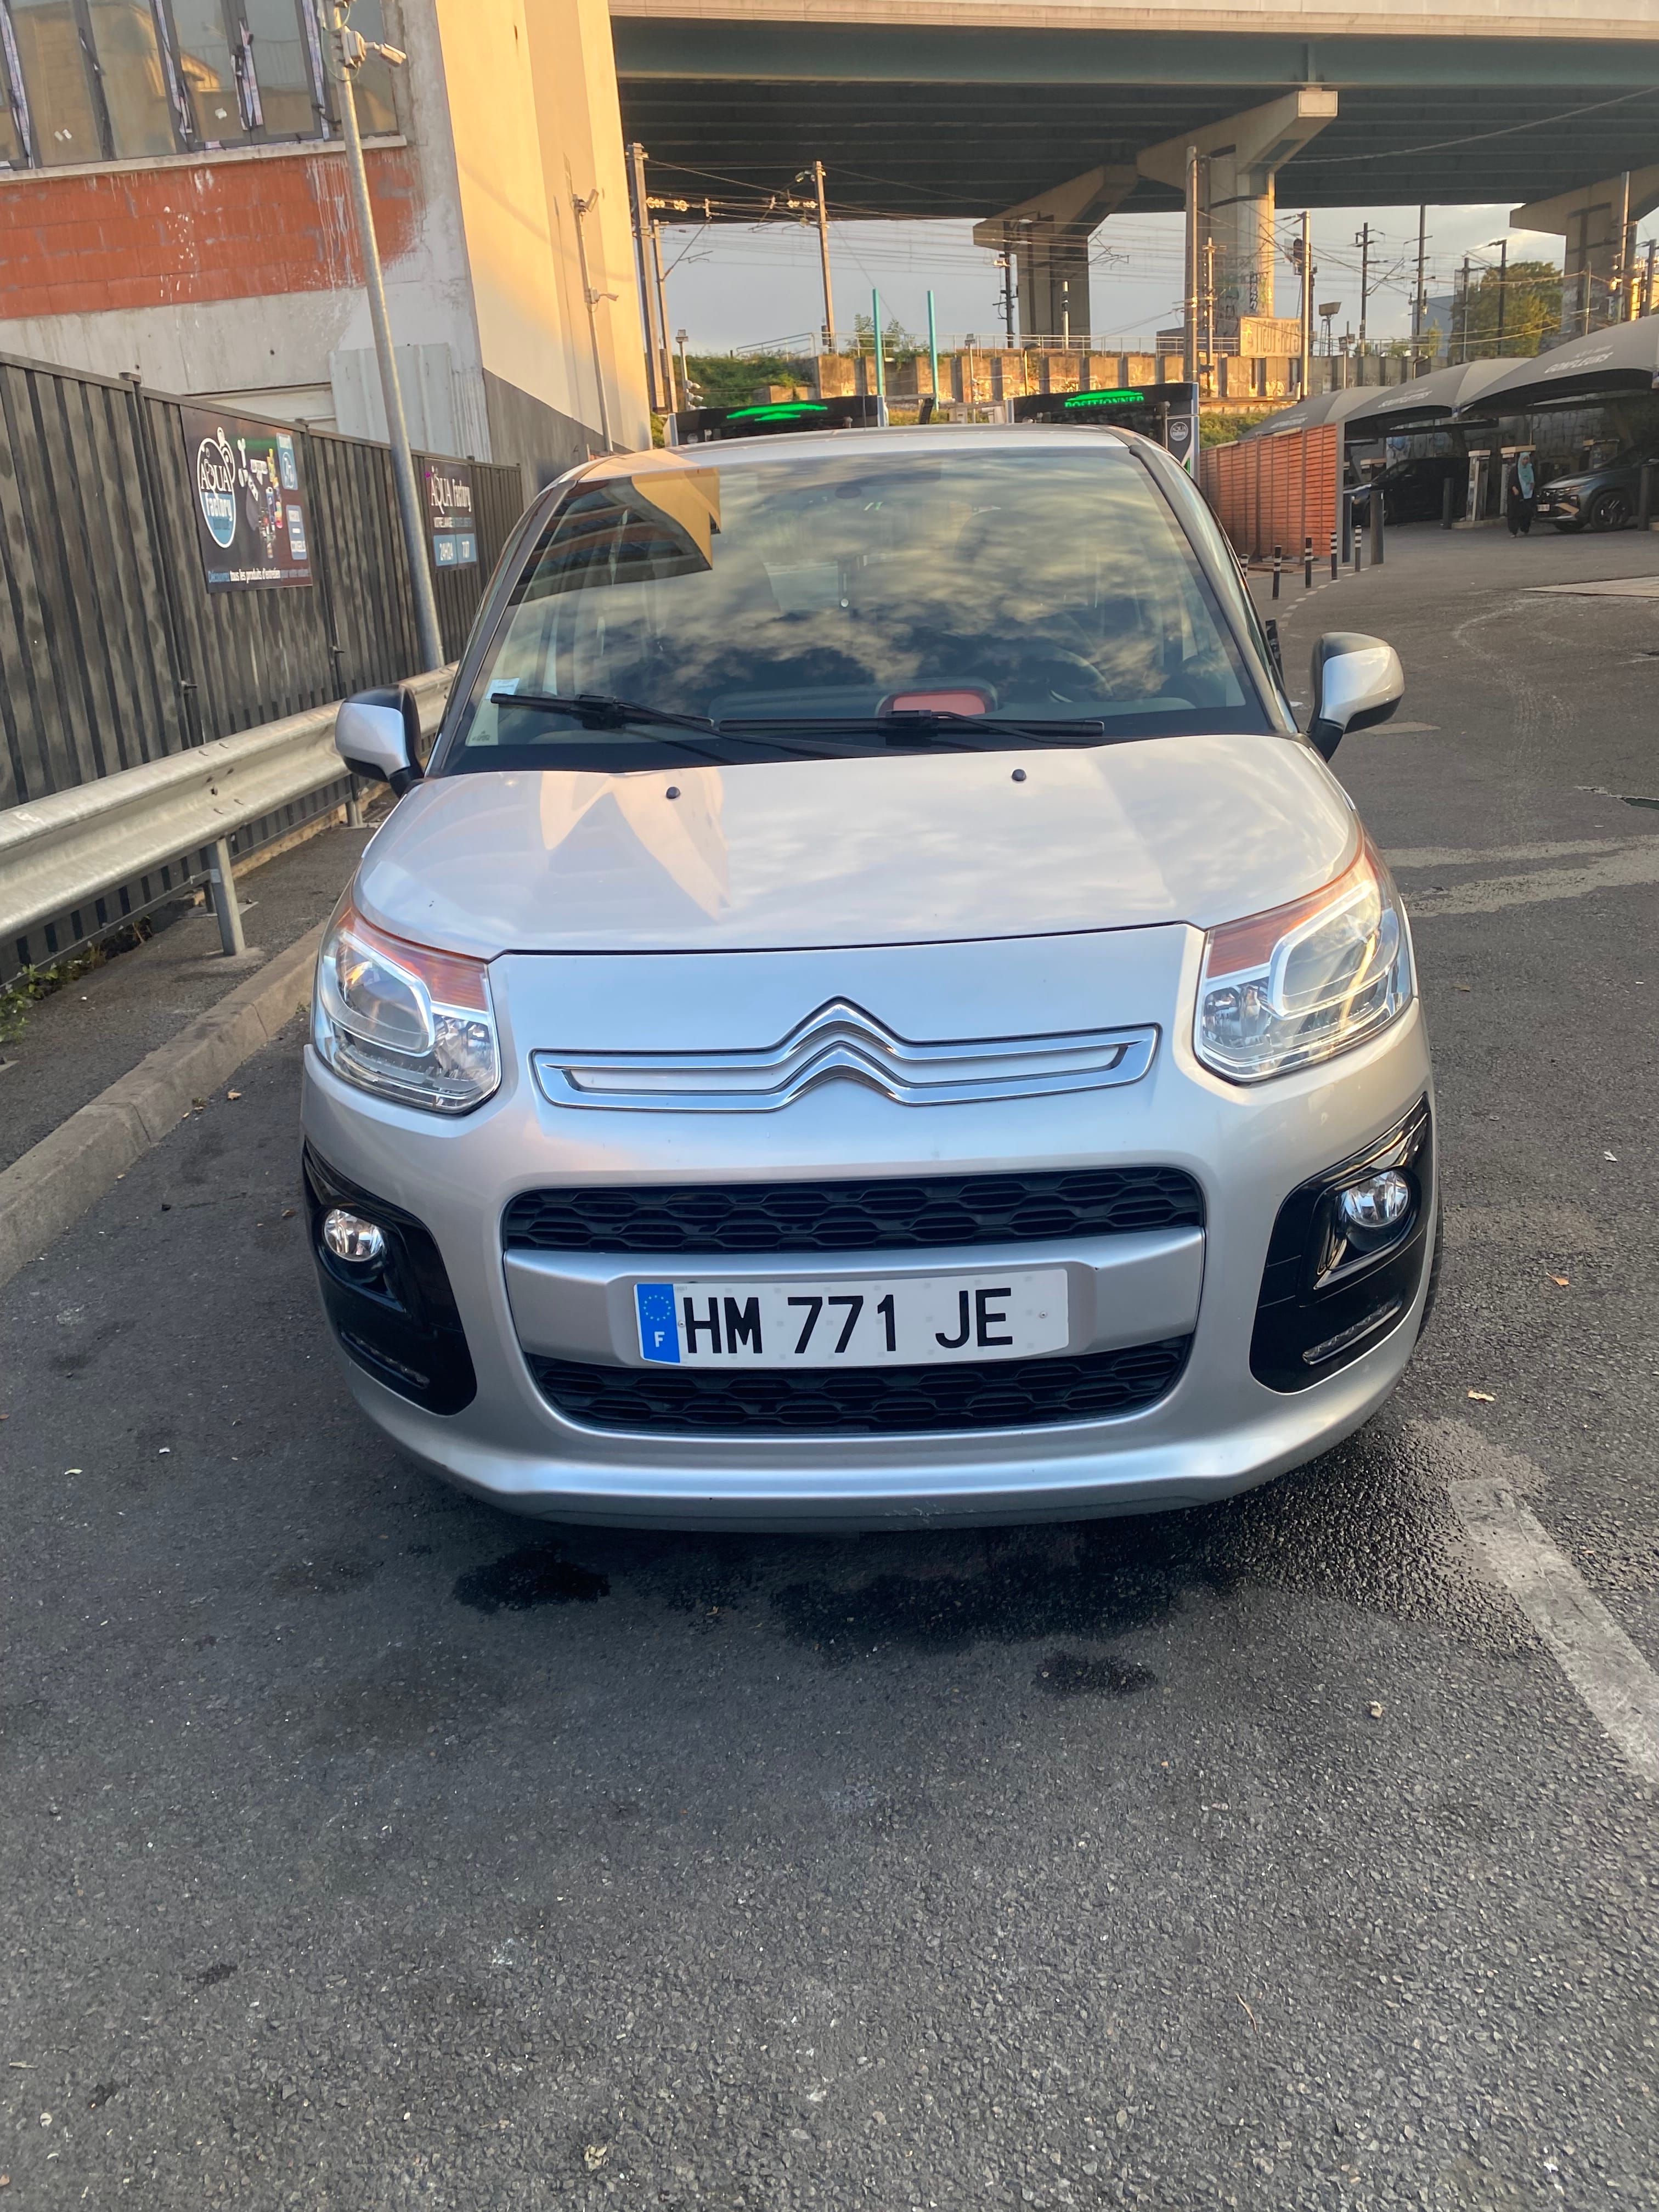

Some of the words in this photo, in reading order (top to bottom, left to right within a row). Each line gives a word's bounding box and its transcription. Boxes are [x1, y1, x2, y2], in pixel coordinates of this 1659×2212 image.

[201, 462, 232, 496] AQUA
[431, 475, 453, 512] AQUA
[683, 1297, 763, 1353] HM
[788, 1294, 896, 1353] 771
[935, 1288, 1013, 1348] JE
[654, 1331, 665, 1347] F
